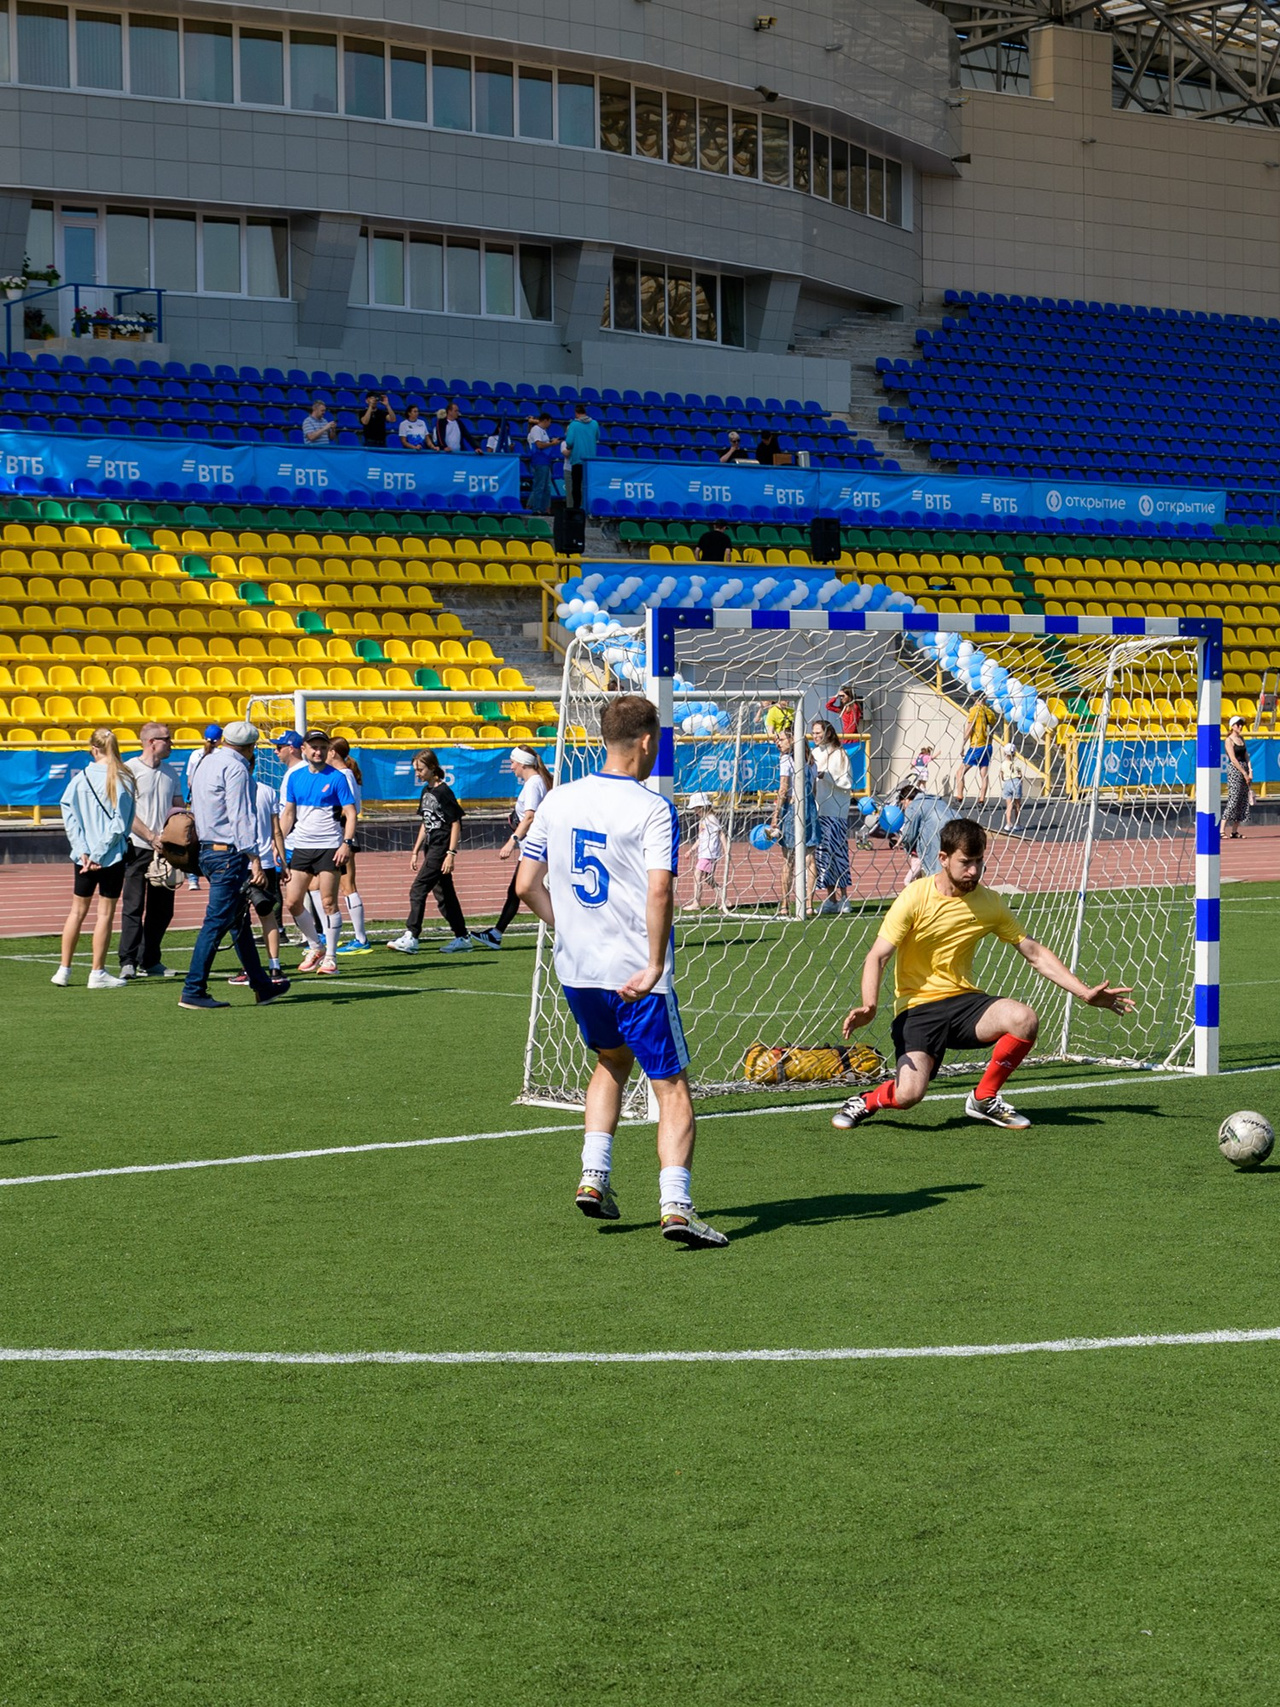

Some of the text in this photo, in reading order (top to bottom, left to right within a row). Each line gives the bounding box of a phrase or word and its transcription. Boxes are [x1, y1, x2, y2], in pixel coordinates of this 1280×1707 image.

[6, 455, 44, 475] ВТБ
[104, 460, 140, 479] ВТБ
[198, 464, 235, 483] ВТБ
[295, 468, 328, 486] ВТБ
[383, 472, 416, 490] ВТБ
[468, 475, 499, 492] ВТБ
[624, 482, 655, 499] ВТБ
[702, 485, 731, 501] ВТБ
[776, 488, 805, 505] ВТБ
[853, 491, 881, 508] ВТБ
[924, 493, 952, 510] ВТБ
[993, 497, 1018, 513] ВТБ
[1065, 496, 1126, 511] открытие
[1156, 500, 1215, 516] открытие
[571, 828, 610, 909] 5
